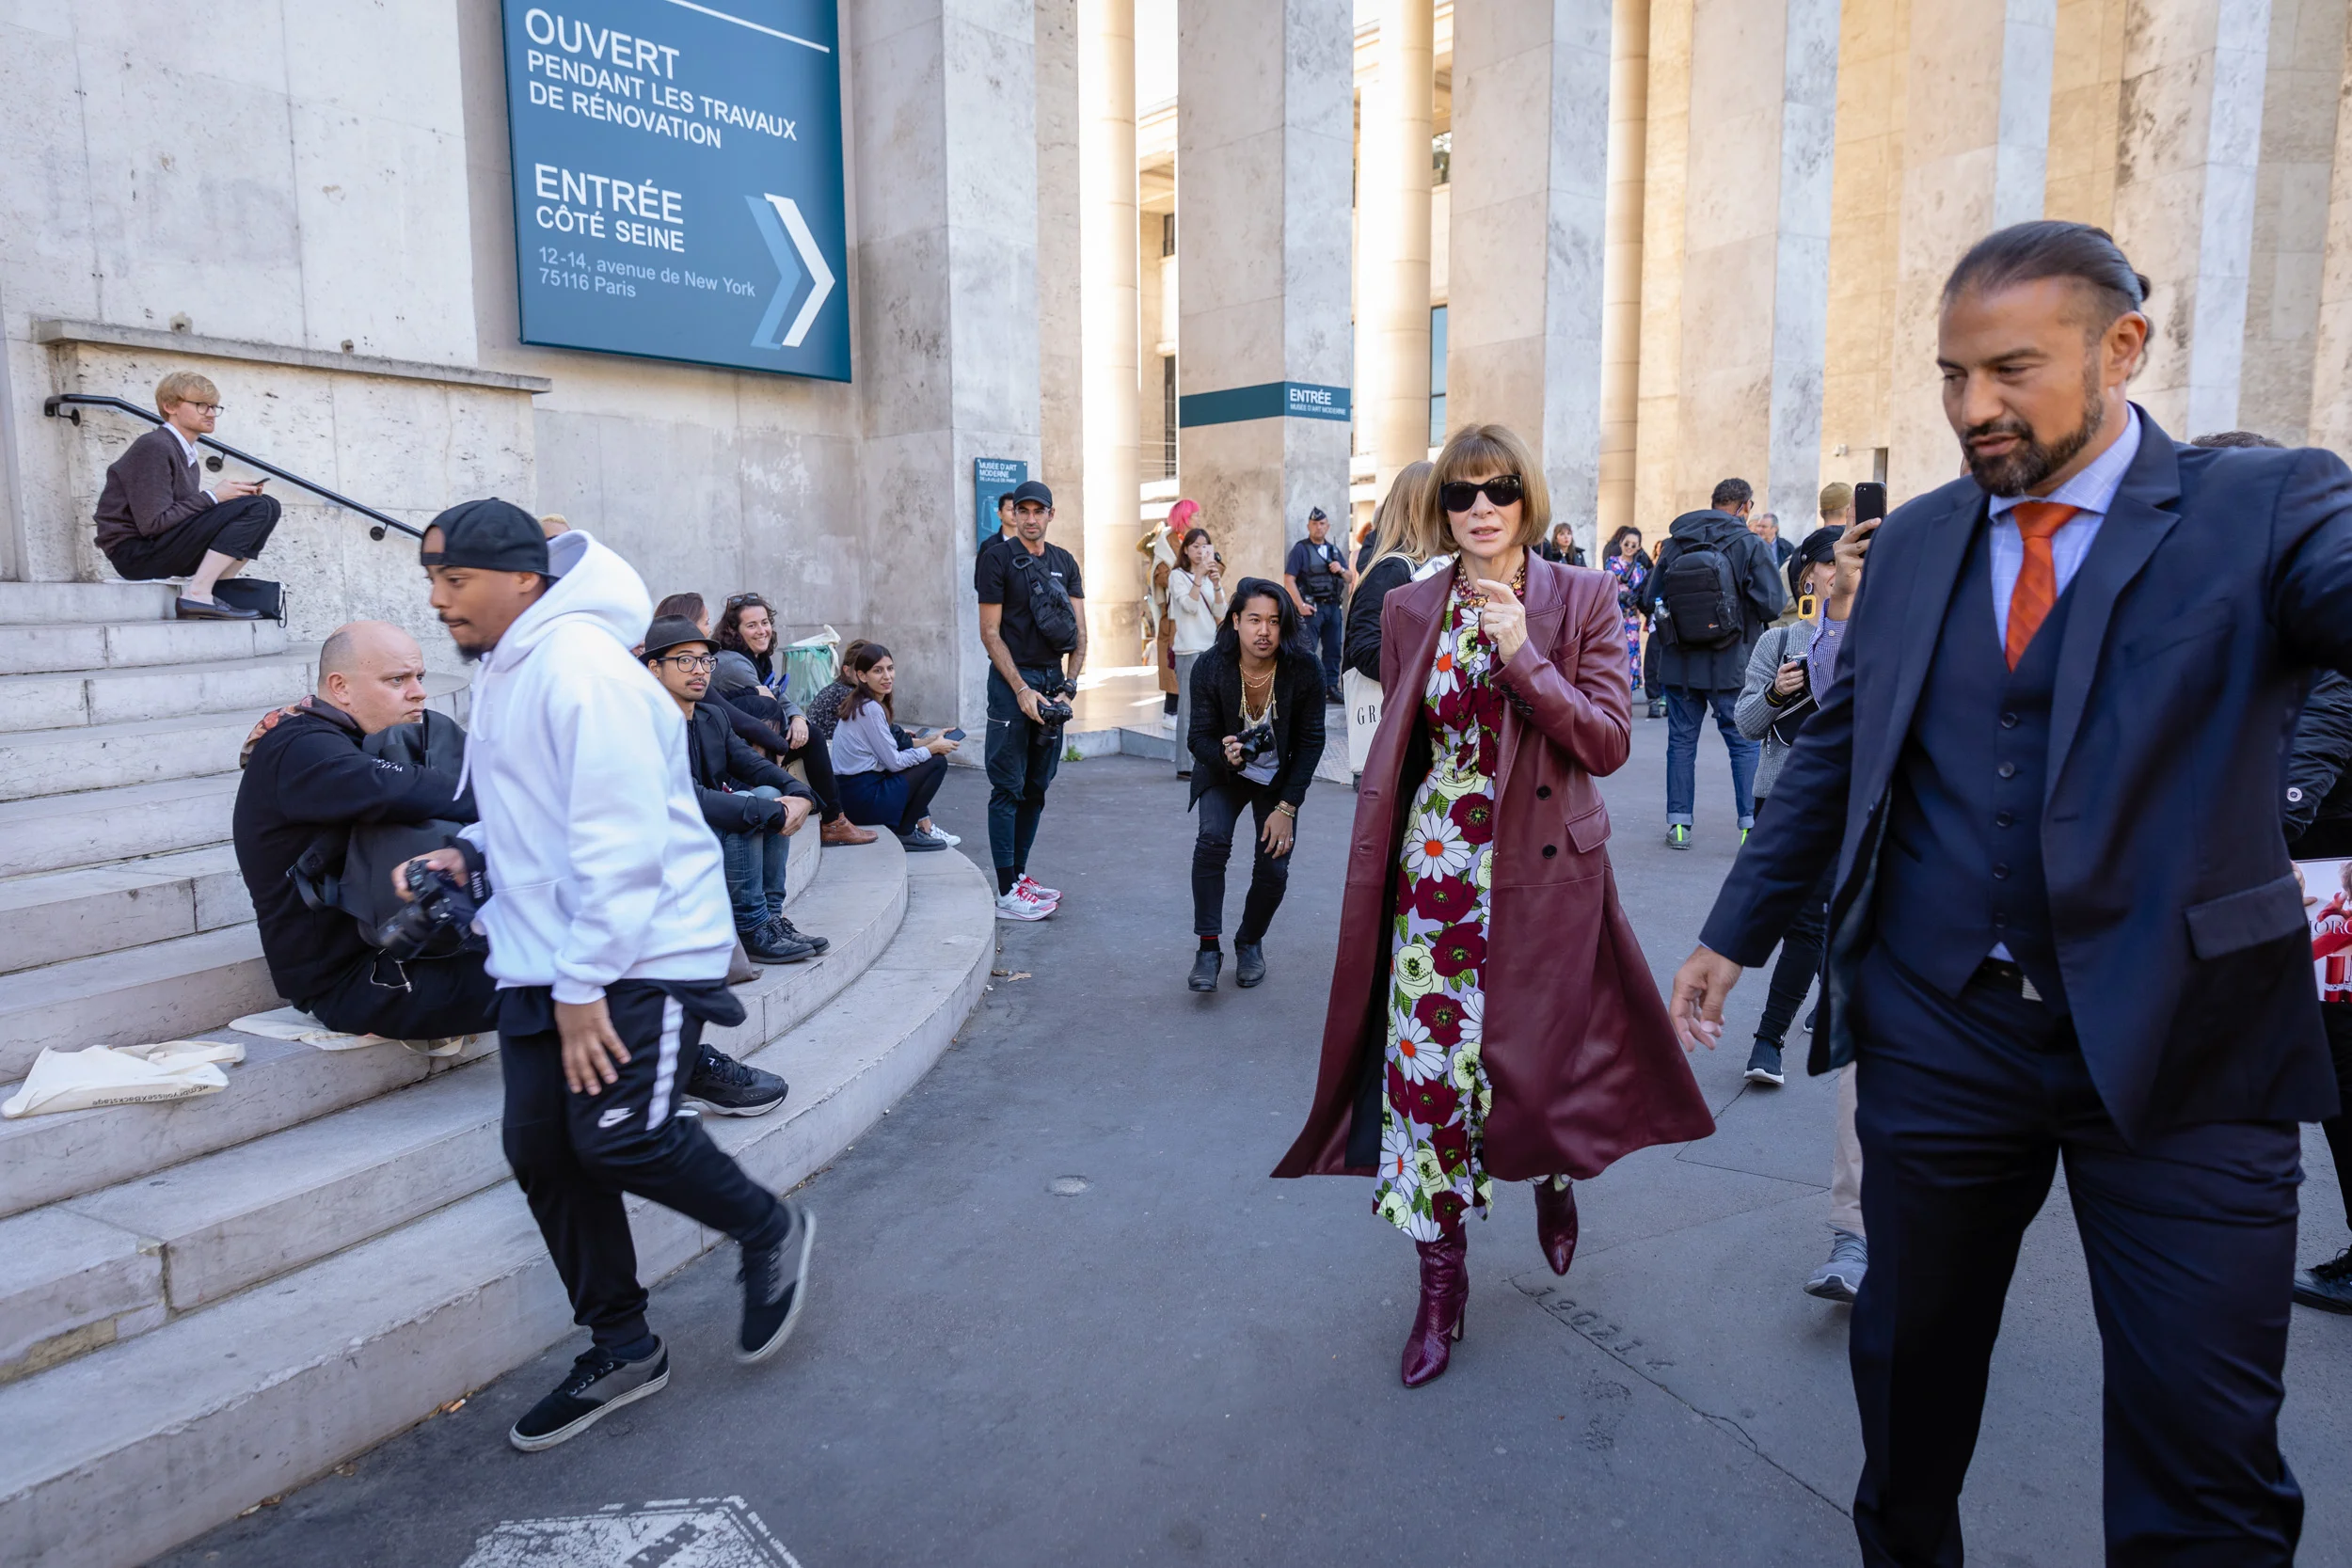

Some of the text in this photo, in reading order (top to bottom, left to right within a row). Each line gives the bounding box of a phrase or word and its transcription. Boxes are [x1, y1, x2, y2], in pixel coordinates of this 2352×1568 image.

[525, 8, 680, 81] OUVERT
[528, 48, 798, 142] PENDANT LES TRAVAUX
[529, 80, 723, 150] DE RÉNOVATION
[534, 162, 684, 225] ENTRÉE
[535, 203, 686, 254] CÔTÉ SEINE
[538, 245, 756, 297] 12-14, avenue de New York
[538, 267, 637, 298] 75116 Paris
[1289, 388, 1332, 405] ENTRÉE
[979, 469, 1010, 479] MODERNE
[1357, 705, 1382, 726] GR
